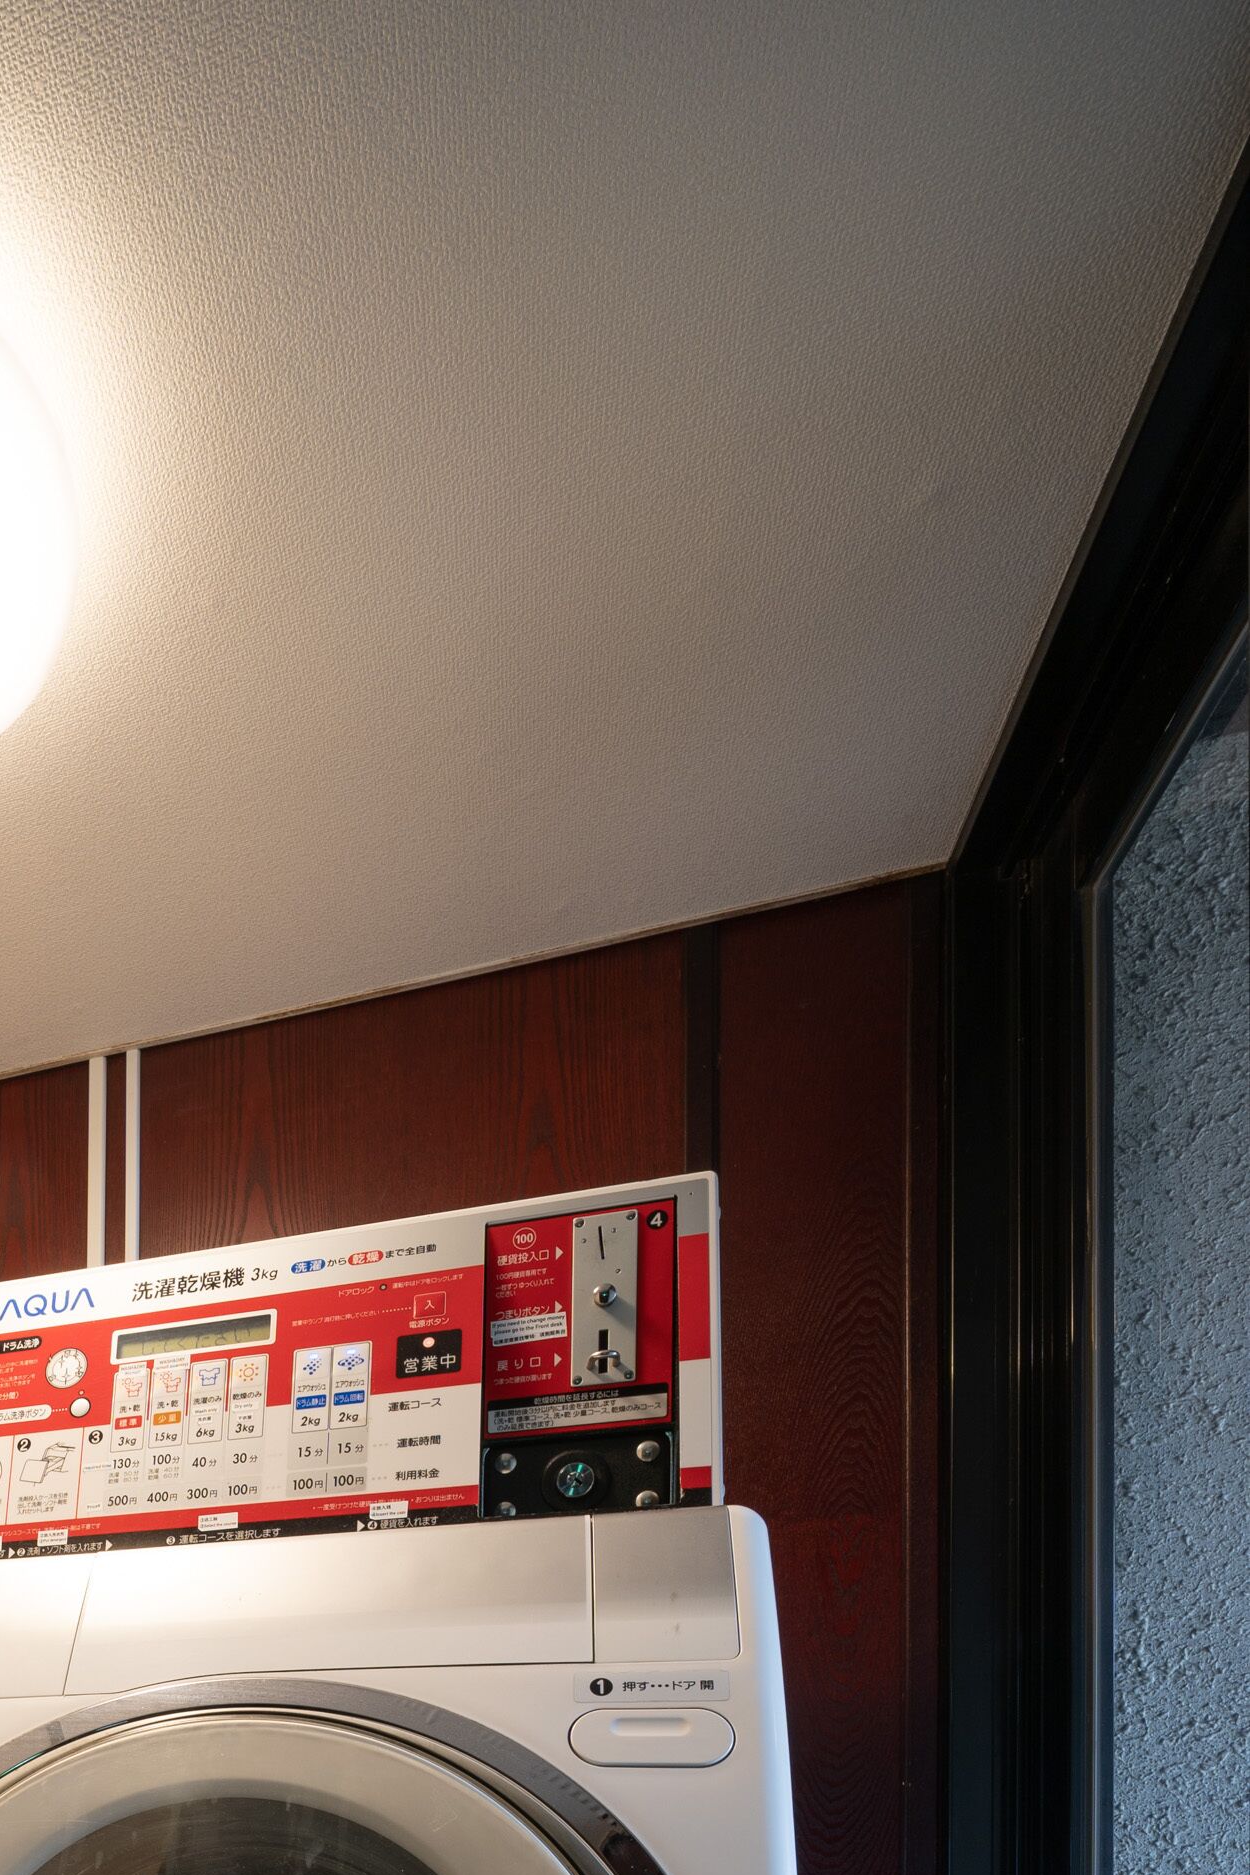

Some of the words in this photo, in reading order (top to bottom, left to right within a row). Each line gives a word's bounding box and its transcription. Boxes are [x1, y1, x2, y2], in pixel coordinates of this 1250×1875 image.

[515, 1233, 534, 1244] 100
[497, 1249, 549, 1266] 硬貨投入口
[132, 1267, 245, 1302] 洗濯乾燥機
[251, 1268, 278, 1281] 3kg
[338, 1286, 374, 1298] ドアロック
[495, 1306, 550, 1319] つまりボタン
[547, 1314, 565, 1322] money
[409, 1318, 449, 1329] 電源ボタン
[494, 1328, 511, 1336] please
[403, 1353, 456, 1374] 営業中
[497, 1357, 541, 1371] 戻り口
[193, 1397, 221, 1405] 洗濯のみ
[233, 1391, 262, 1400] 乾燥のみ
[534, 1389, 619, 1405] 乾燥時間を延長するには
[388, 1398, 442, 1412] 運転コース
[301, 1416, 320, 1427] 2kg
[338, 1412, 358, 1423] 2kg
[196, 1429, 214, 1439] 6kg
[236, 1424, 254, 1434] 3kg
[118, 1436, 136, 1447] 3kg
[155, 1432, 177, 1443] 1.5kg
[397, 1435, 441, 1448] 運転時間
[113, 1458, 139, 1469] 130分
[153, 1454, 180, 1465] 100分
[395, 1469, 440, 1481] 利用料金
[293, 1479, 323, 1490] 100円
[333, 1475, 364, 1487] 100円
[187, 1488, 217, 1499] 300円
[228, 1485, 258, 1496] 100円
[108, 1496, 137, 1507] 500円
[147, 1492, 177, 1503] 400円
[380, 1516, 438, 1529] 硬貨を入れます
[179, 1528, 281, 1545] 運転コースを選択します
